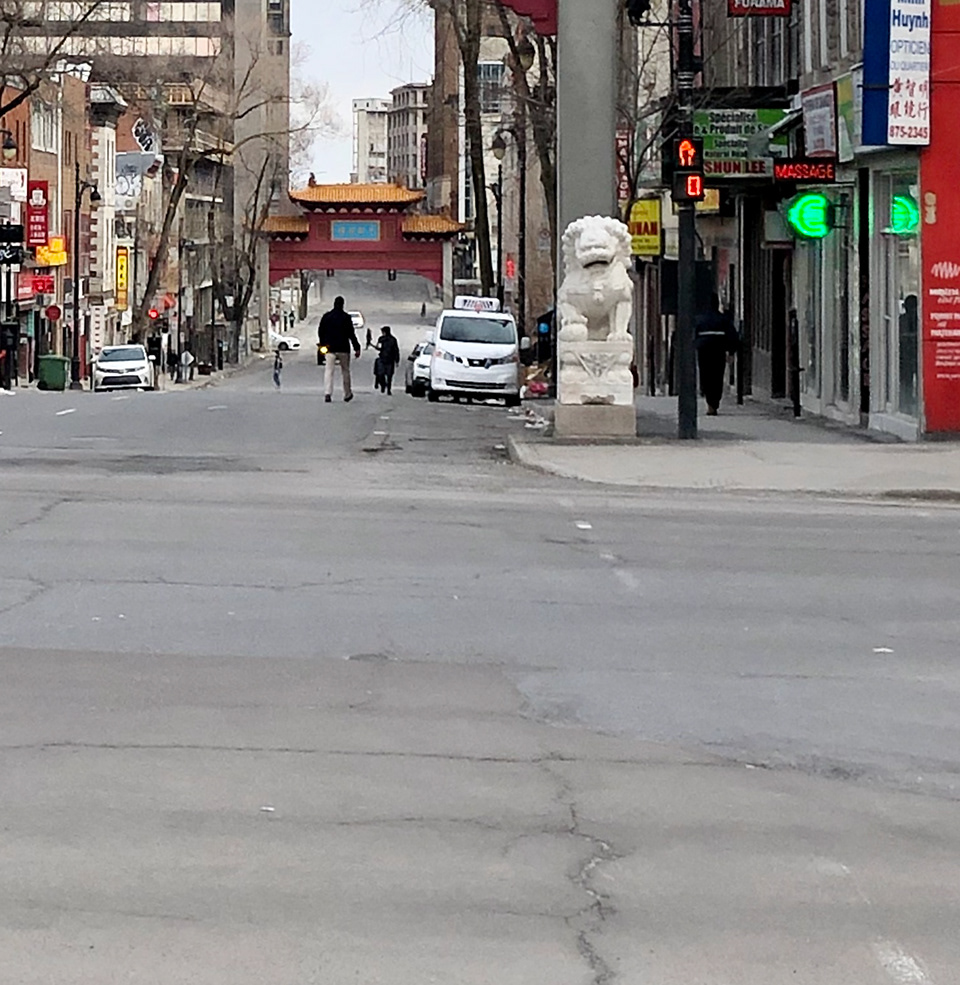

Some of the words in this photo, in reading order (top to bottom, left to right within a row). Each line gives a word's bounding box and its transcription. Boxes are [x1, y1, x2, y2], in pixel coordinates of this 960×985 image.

[892, 9, 929, 32] Huynh
[890, 39, 930, 56] OPTICIEN
[890, 125, 929, 140] 875-2345
[704, 160, 741, 174] SHUN
[746, 160, 766, 174] LEE
[775, 163, 834, 179] MASSAGE
